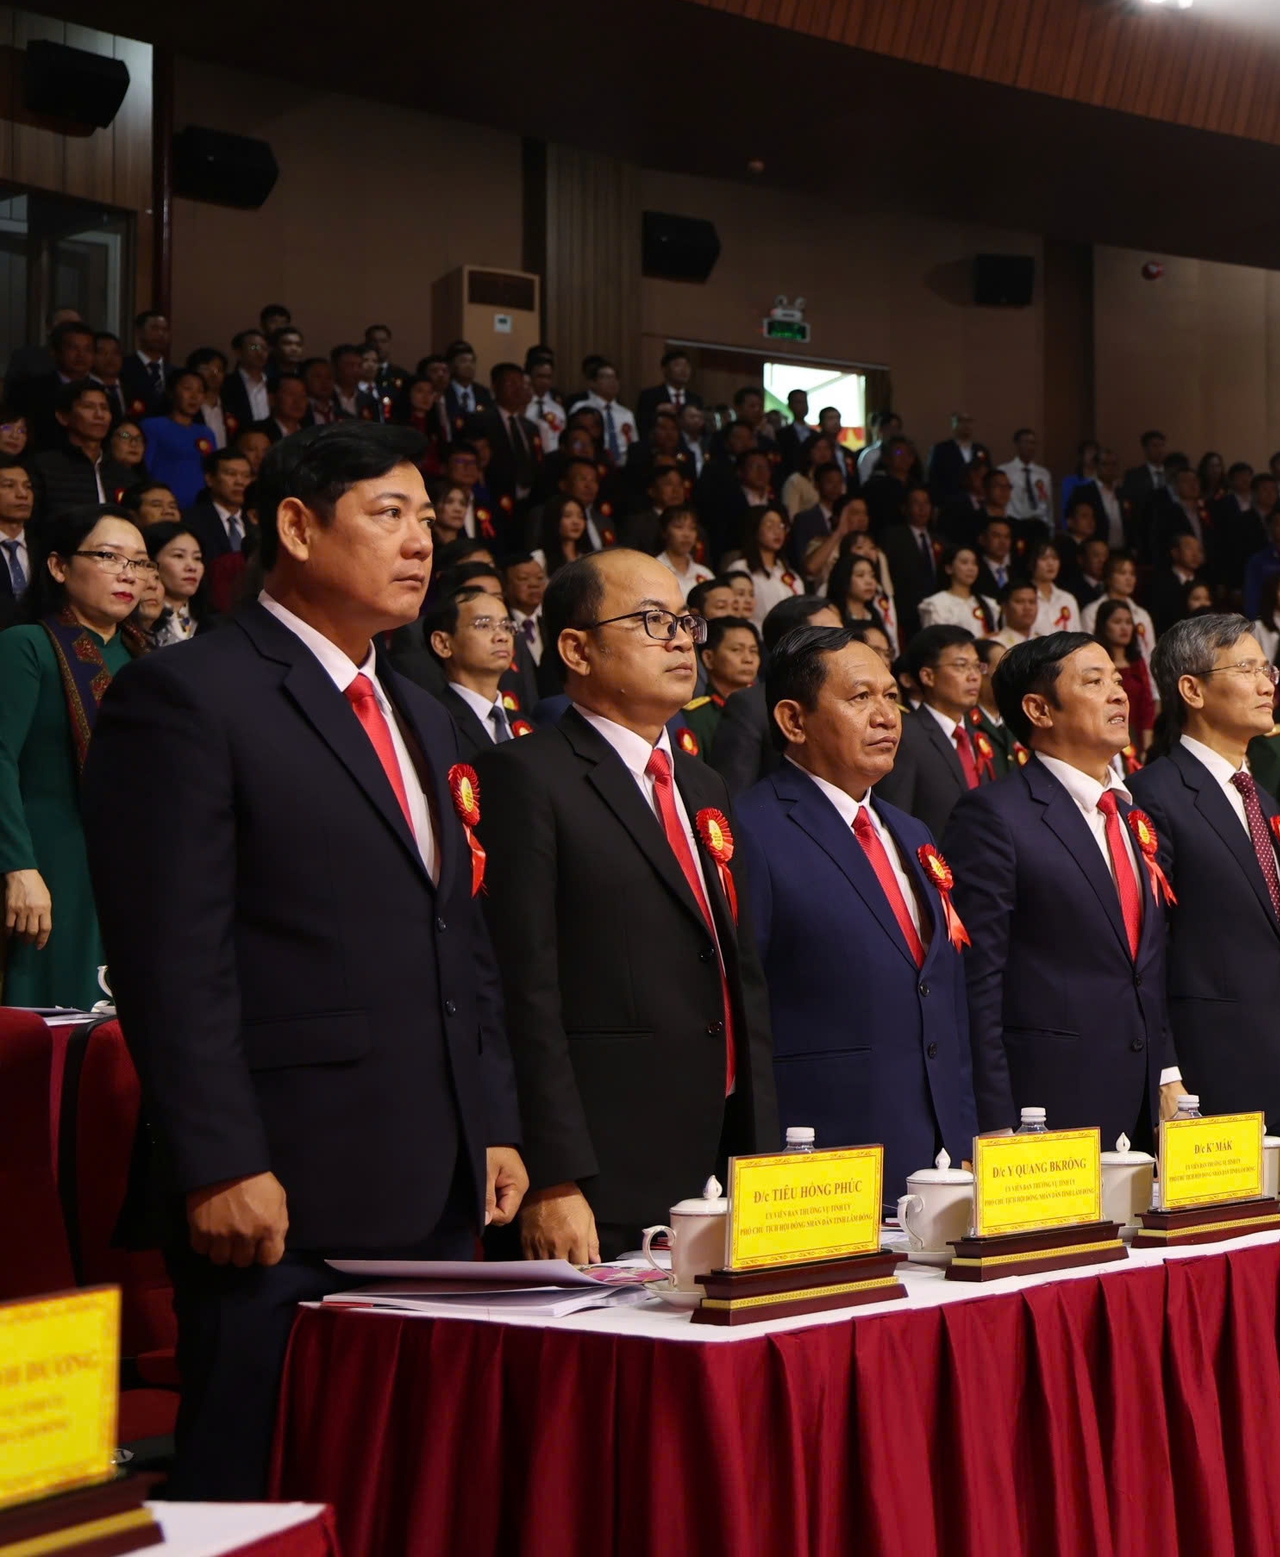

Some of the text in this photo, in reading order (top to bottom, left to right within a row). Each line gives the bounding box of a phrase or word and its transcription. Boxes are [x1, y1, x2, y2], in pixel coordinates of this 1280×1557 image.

[1007, 1165, 1013, 1176] Y
[1015, 1162, 1048, 1178] QUANG
[1049, 1156, 1086, 1172] BKRÔNG
[753, 1190, 770, 1203] Đ/c
[772, 1184, 798, 1201] TIÊU
[834, 1178, 863, 1194] PHÚC
